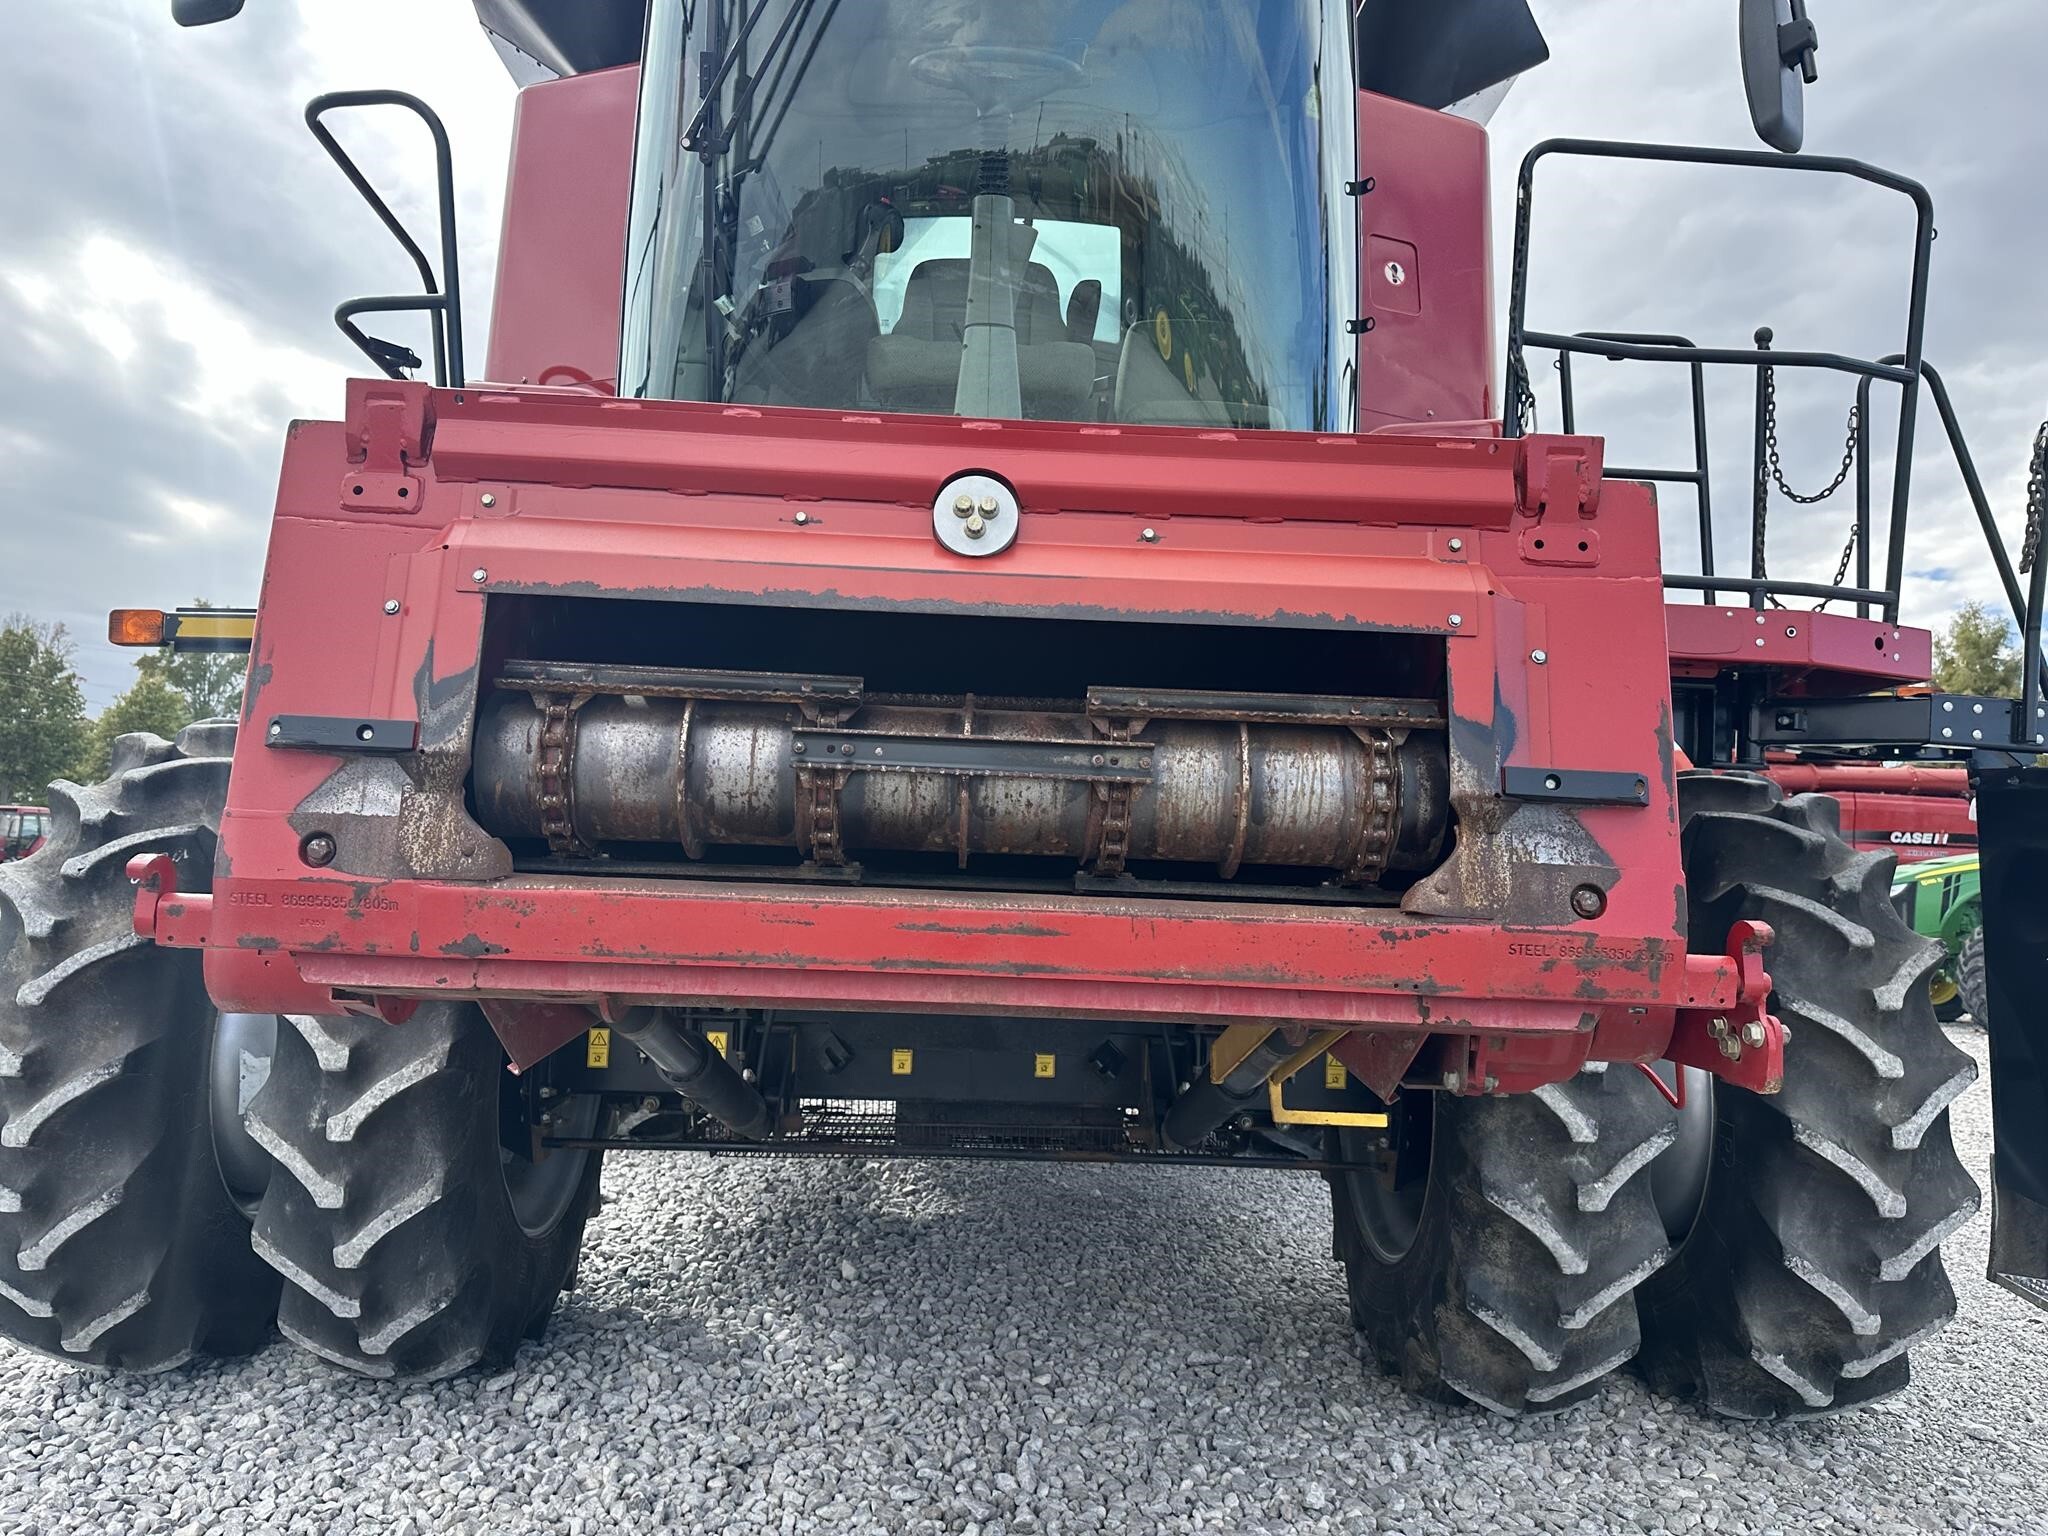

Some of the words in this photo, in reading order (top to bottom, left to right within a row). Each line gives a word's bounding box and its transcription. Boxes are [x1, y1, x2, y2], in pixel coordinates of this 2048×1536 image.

[1890, 831, 1933, 845] CASE
[230, 891, 273, 907] STEEL
[1508, 943, 1550, 957] STEEL
